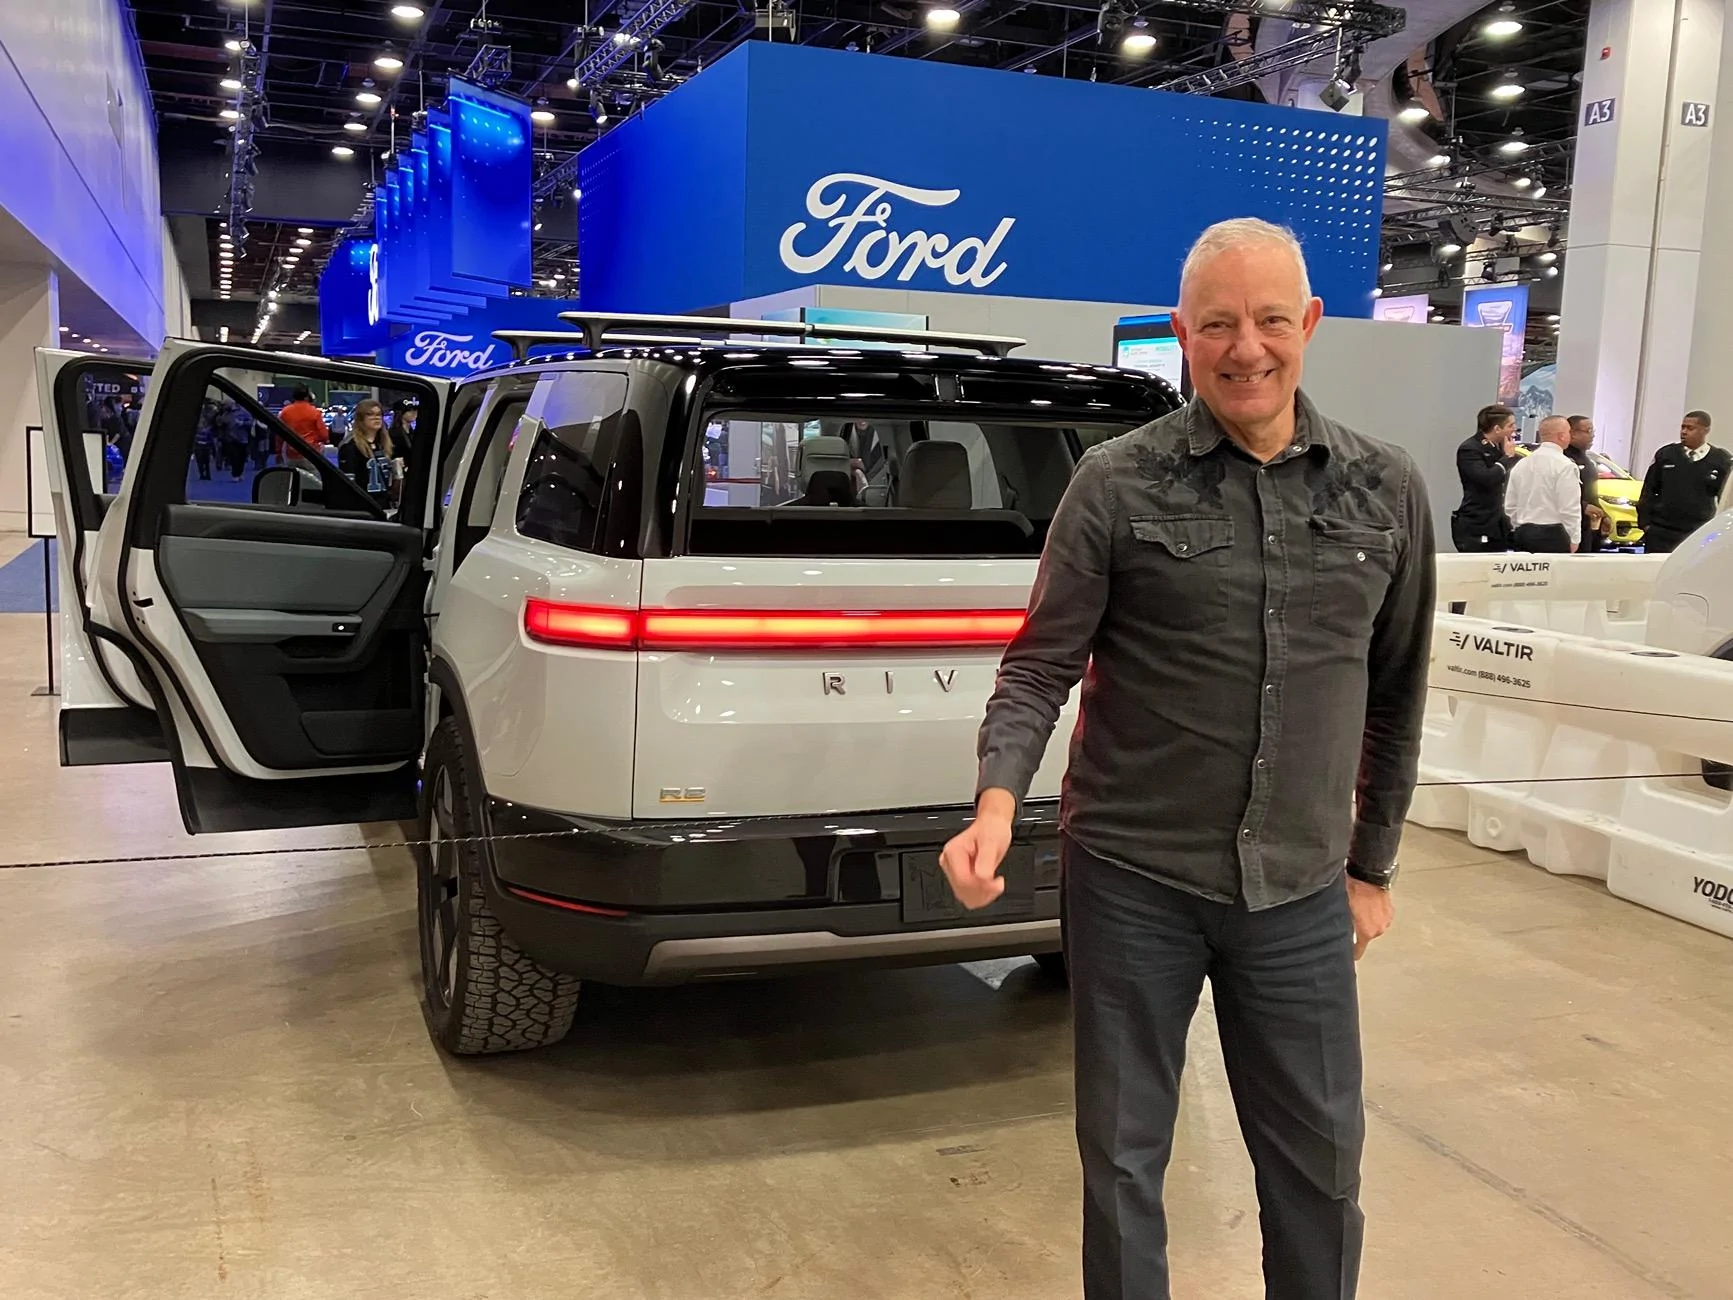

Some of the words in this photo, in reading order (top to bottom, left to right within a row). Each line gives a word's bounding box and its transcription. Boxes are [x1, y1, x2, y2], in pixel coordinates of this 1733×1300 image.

[1589, 100, 1612, 124] A3
[1685, 103, 1706, 125] A3
[779, 173, 1016, 288] Ford
[405, 331, 496, 369] Ford
[1510, 562, 1550, 572] VALTIR
[1473, 635, 1533, 661] VALTIR
[823, 669, 999, 695] RIV
